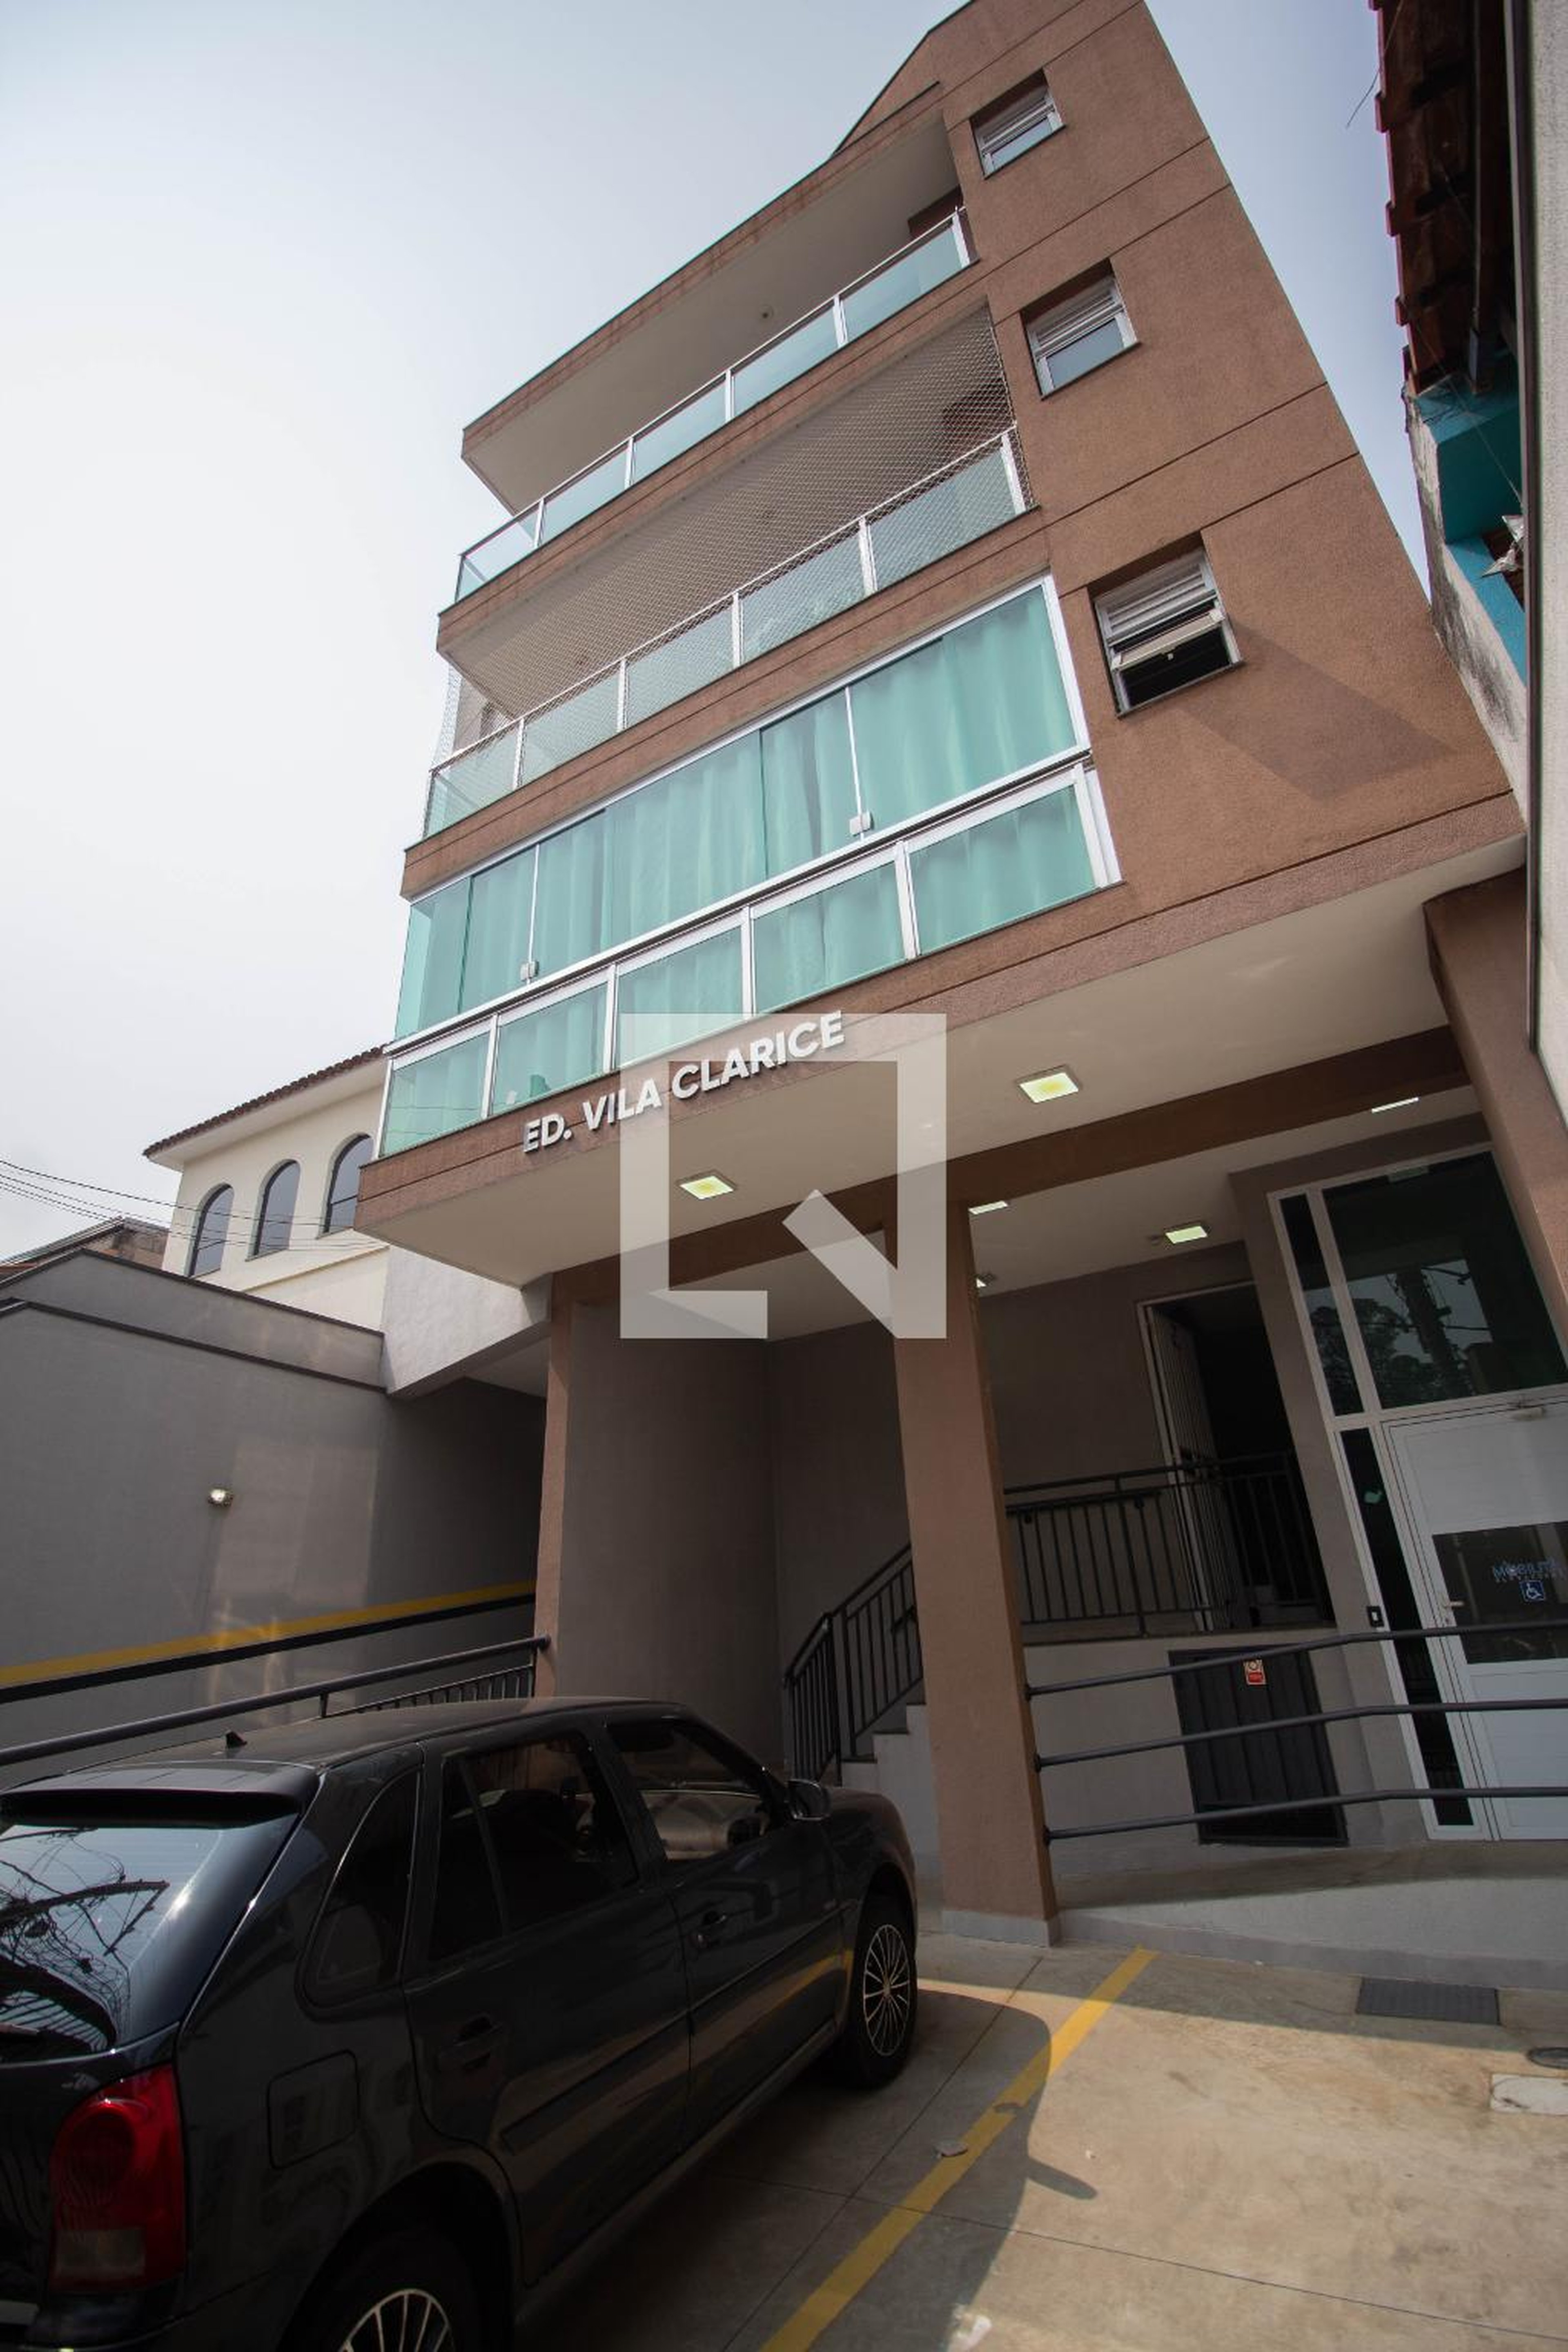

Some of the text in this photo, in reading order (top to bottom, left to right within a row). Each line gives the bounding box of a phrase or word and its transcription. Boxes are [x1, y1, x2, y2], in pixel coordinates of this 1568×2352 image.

[523, 1010, 844, 1153] ED. VILA CLARICE
